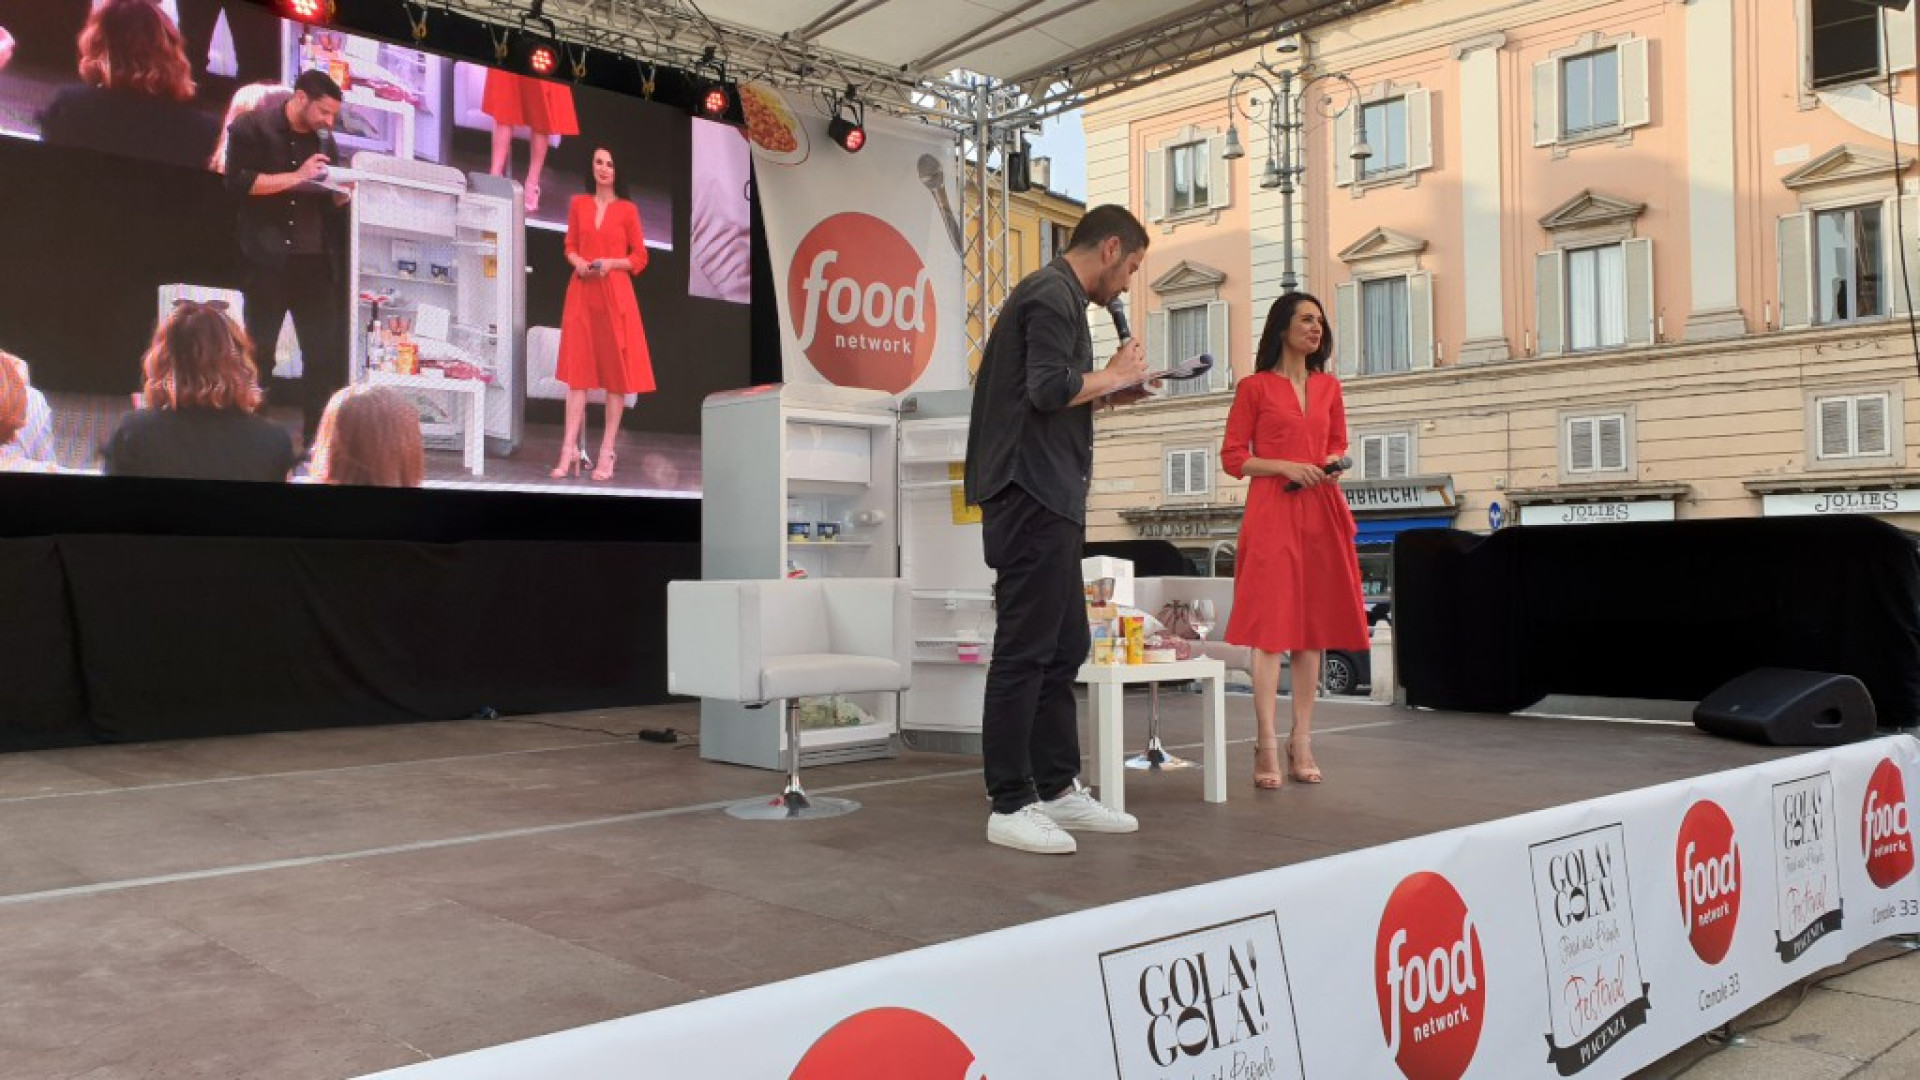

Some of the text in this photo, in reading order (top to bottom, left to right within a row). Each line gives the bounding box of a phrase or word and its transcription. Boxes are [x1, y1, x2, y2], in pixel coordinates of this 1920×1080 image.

[798, 250, 926, 350] food
[835, 332, 912, 355] network
[1345, 486, 1418, 505] ABACCHI
[1814, 492, 1898, 512] JOLIES
[1562, 504, 1629, 522] JOLIES
[1684, 834, 1737, 931] food
[1899, 899, 1918, 917] 33
[1387, 914, 1477, 1050] food
[1413, 1003, 1470, 1043] network
[1580, 1016, 1627, 1064] PIACENZA
